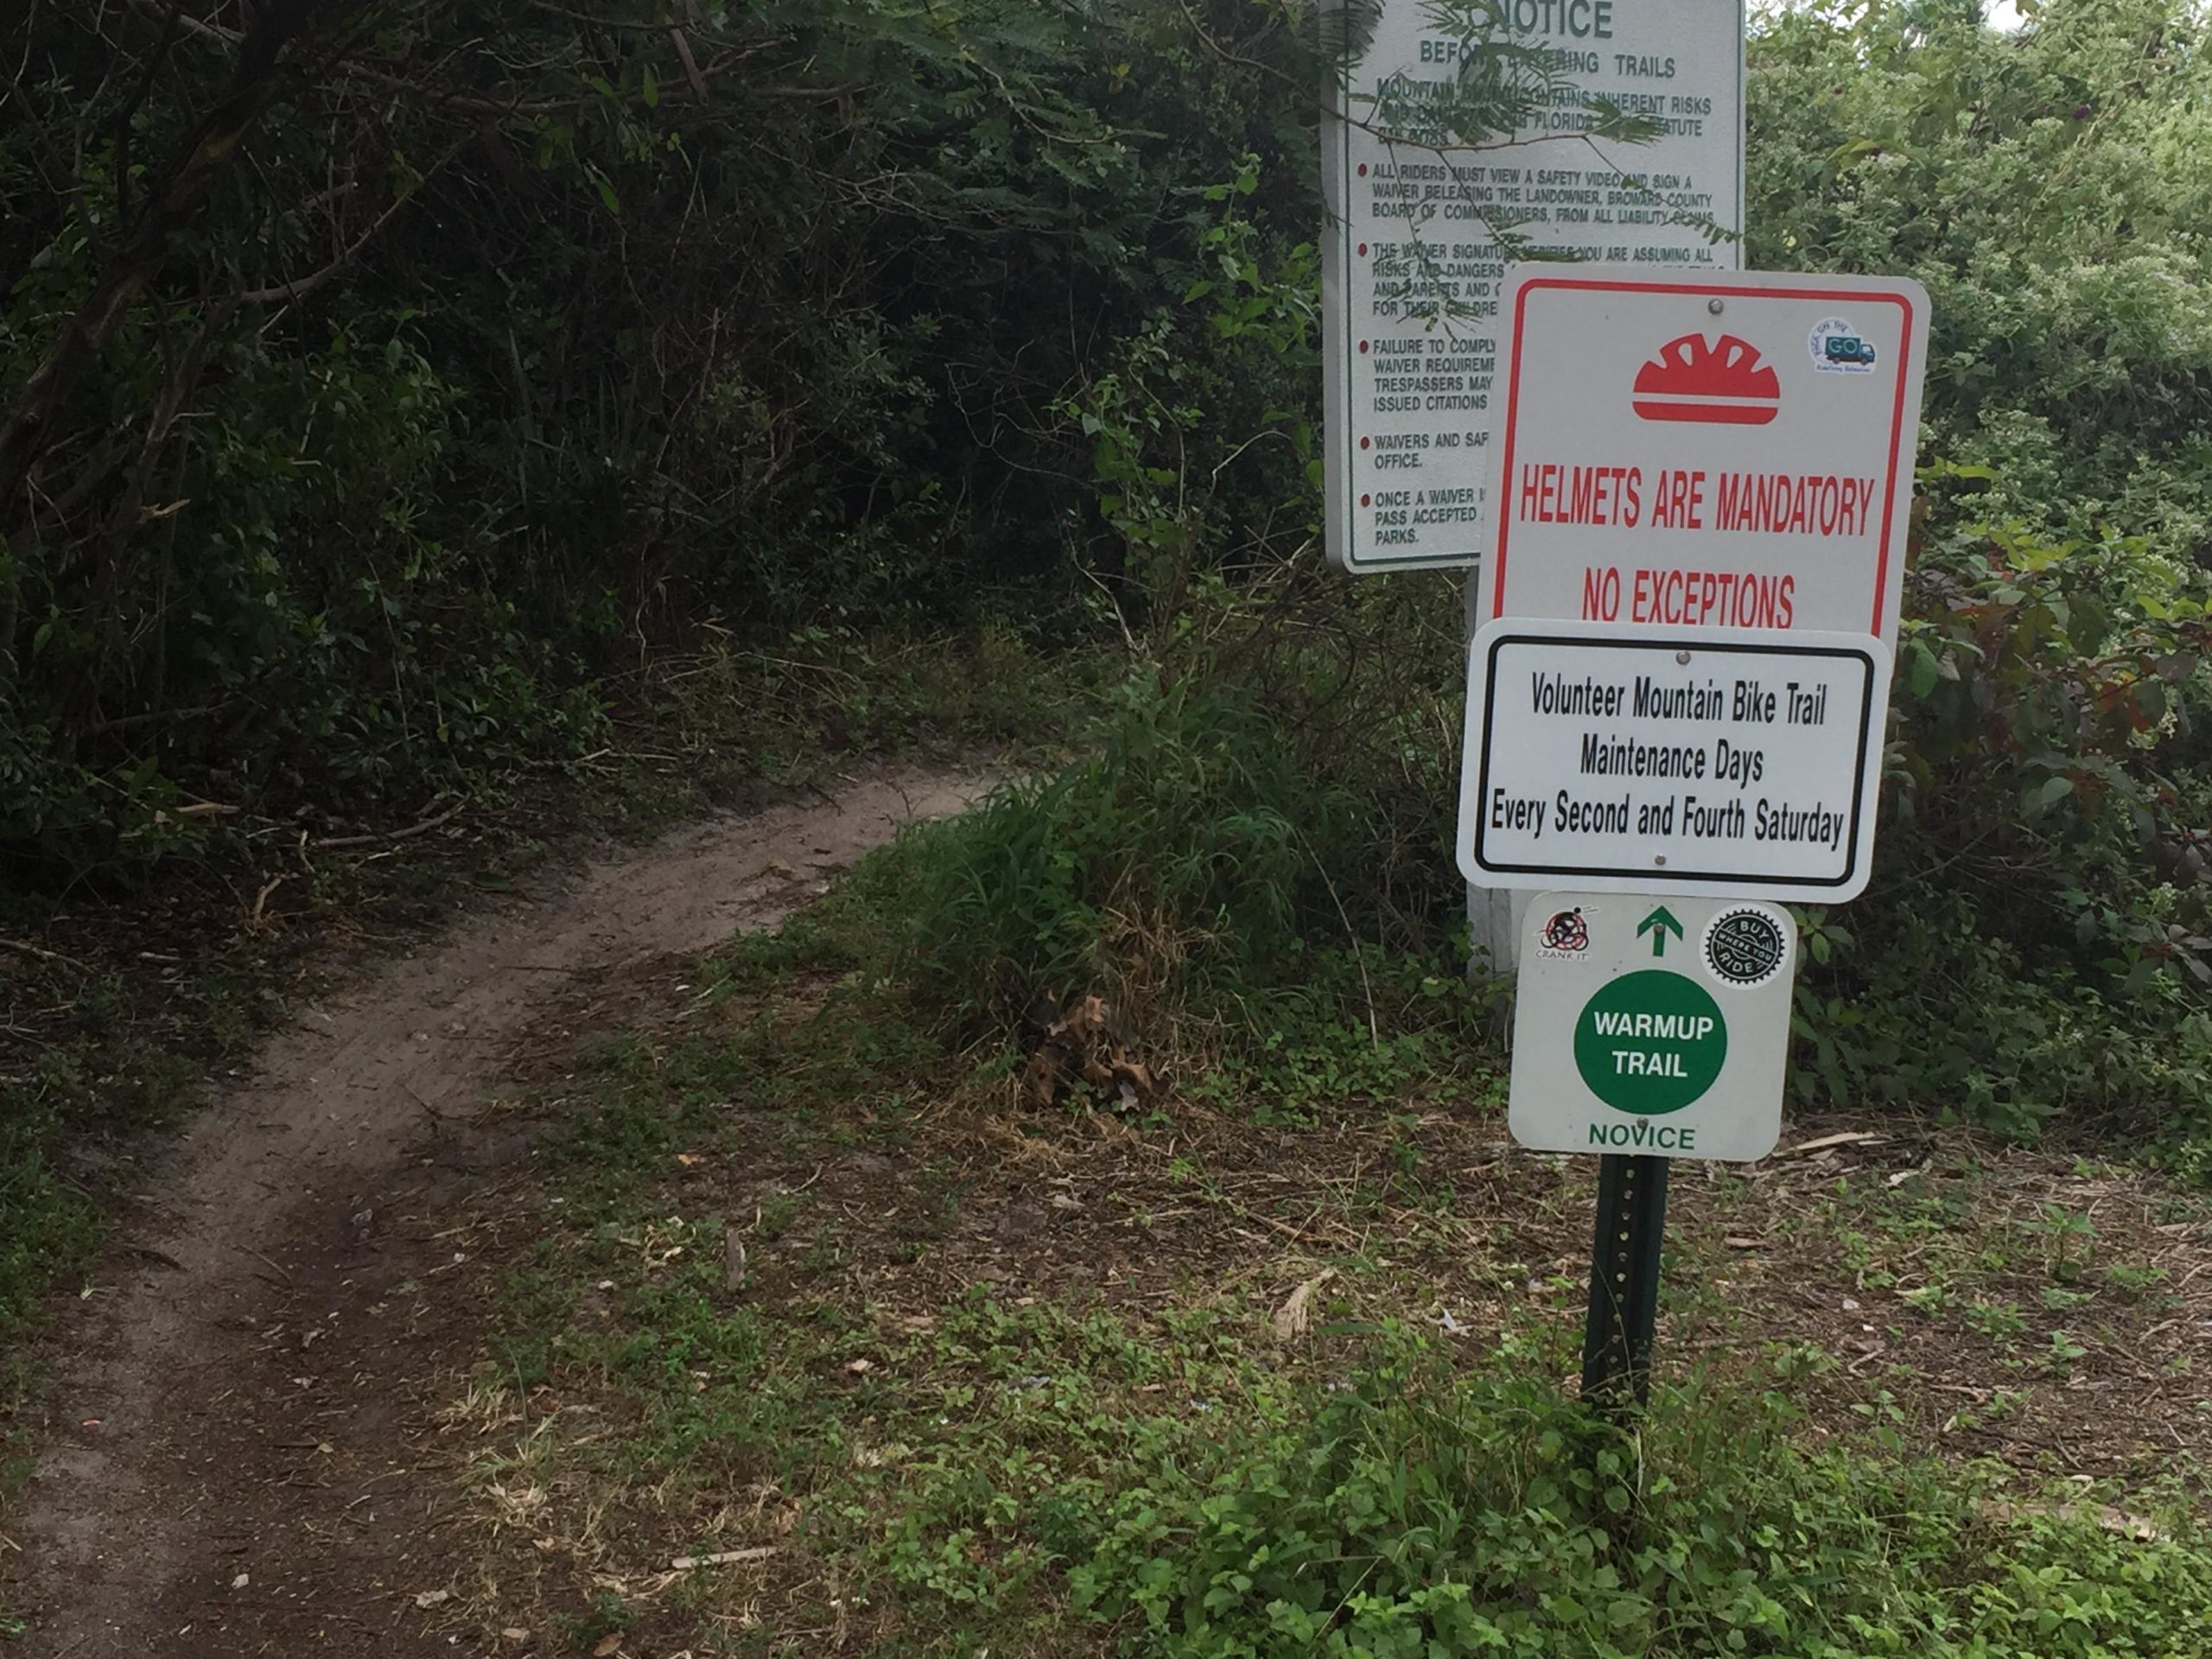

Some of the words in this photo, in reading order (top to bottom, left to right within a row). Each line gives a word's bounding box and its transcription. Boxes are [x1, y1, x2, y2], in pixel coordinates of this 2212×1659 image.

[1420, 40, 1500, 67] BEFO
[1615, 54, 1676, 79] TRAILS
[1596, 92, 1666, 112] NHERENT
[1671, 97, 1712, 115] RISKS
[1535, 110, 1594, 130] FLORIDA
[1372, 163, 1395, 179] ALL
[1400, 164, 1447, 181] RIDERS
[1452, 166, 1486, 182] MUST
[1491, 168, 1521, 184] VIEW
[1524, 169, 1533, 185] A
[1537, 169, 1581, 186] SAFETY
[1586, 171, 1621, 187] VIDEO
[1653, 174, 1681, 189] SIGN
[1685, 175, 1693, 189] A
[1372, 183, 1419, 200] WAIVER
[1425, 185, 1493, 201] RELEASING
[1497, 187, 1521, 202] THE
[1607, 191, 1662, 207] BROWARD
[1667, 194, 1713, 208] COUNTY
[1372, 202, 1415, 218] BOARD
[1421, 204, 1437, 219] OF
[1556, 207, 1589, 223] FROM
[1593, 209, 1614, 224] ALL
[1618, 210, 1669, 225] LIABILITY
[1372, 243, 1397, 258] THE
[1580, 246, 1602, 261] YOU
[1607, 246, 1629, 261] ARE
[1634, 246, 1690, 262] ASSUMING
[1694, 248, 1714, 263] ALL
[1372, 263, 1410, 277] RISKS
[1446, 263, 1505, 278] DANGERS
[1373, 282, 1399, 297] AND
[1465, 283, 1491, 297] AND
[1372, 302, 1398, 316] FOR
[1373, 339, 1424, 355] FAILURE
[1428, 339, 1446, 354] TO
[1449, 338, 1497, 354] COMPLY
[1828, 338, 1858, 353] GO
[1374, 358, 1421, 374] WAIVER
[1375, 376, 1464, 392] TRESPASSERS
[1469, 375, 1494, 391] MAY
[1374, 396, 1421, 413] ISSUED
[1426, 394, 1488, 410] CITATIONS
[1375, 433, 1430, 450] WAIVERS
[1434, 433, 1460, 448] AND
[1375, 453, 1423, 470] OFFICE.
[1375, 491, 1411, 508] ONCE
[1415, 490, 1425, 505] A
[1428, 488, 1474, 505] WAIVER
[1521, 463, 1642, 529] HELMETS
[1651, 469, 1706, 531] ARE
[1715, 473, 1875, 537] MANDATORY
[1375, 510, 1408, 527] PASS
[1412, 506, 1477, 524] ACCEPTED
[1375, 528, 1420, 546] PARKS.
[1582, 566, 1621, 622] NO
[1631, 569, 1796, 629] EXCEPTIONS
[1531, 671, 1625, 717] Volunteer
[1632, 676, 1723, 721] Mountain
[1732, 680, 1777, 723] Bike
[1786, 683, 1827, 725] Trail
[1580, 733, 1706, 779] Maintenance
[1714, 738, 1764, 789] Days
[1491, 787, 1547, 839] Every
[1554, 789, 1630, 836] Second
[1637, 795, 1675, 836] and
[1681, 796, 1745, 840] Fourth
[1754, 798, 1845, 852] Saturday
[1740, 920, 1770, 939] BUY
[1535, 950, 1574, 960] CRANK
[1719, 932, 1751, 951] WHERE
[1752, 947, 1772, 961] YOU
[1719, 951, 1754, 974] RIDE
[1593, 1011, 1714, 1040] WARMUP
[1611, 1050, 1688, 1077] TRAIL
[1588, 1122, 1696, 1151] NOVICE
